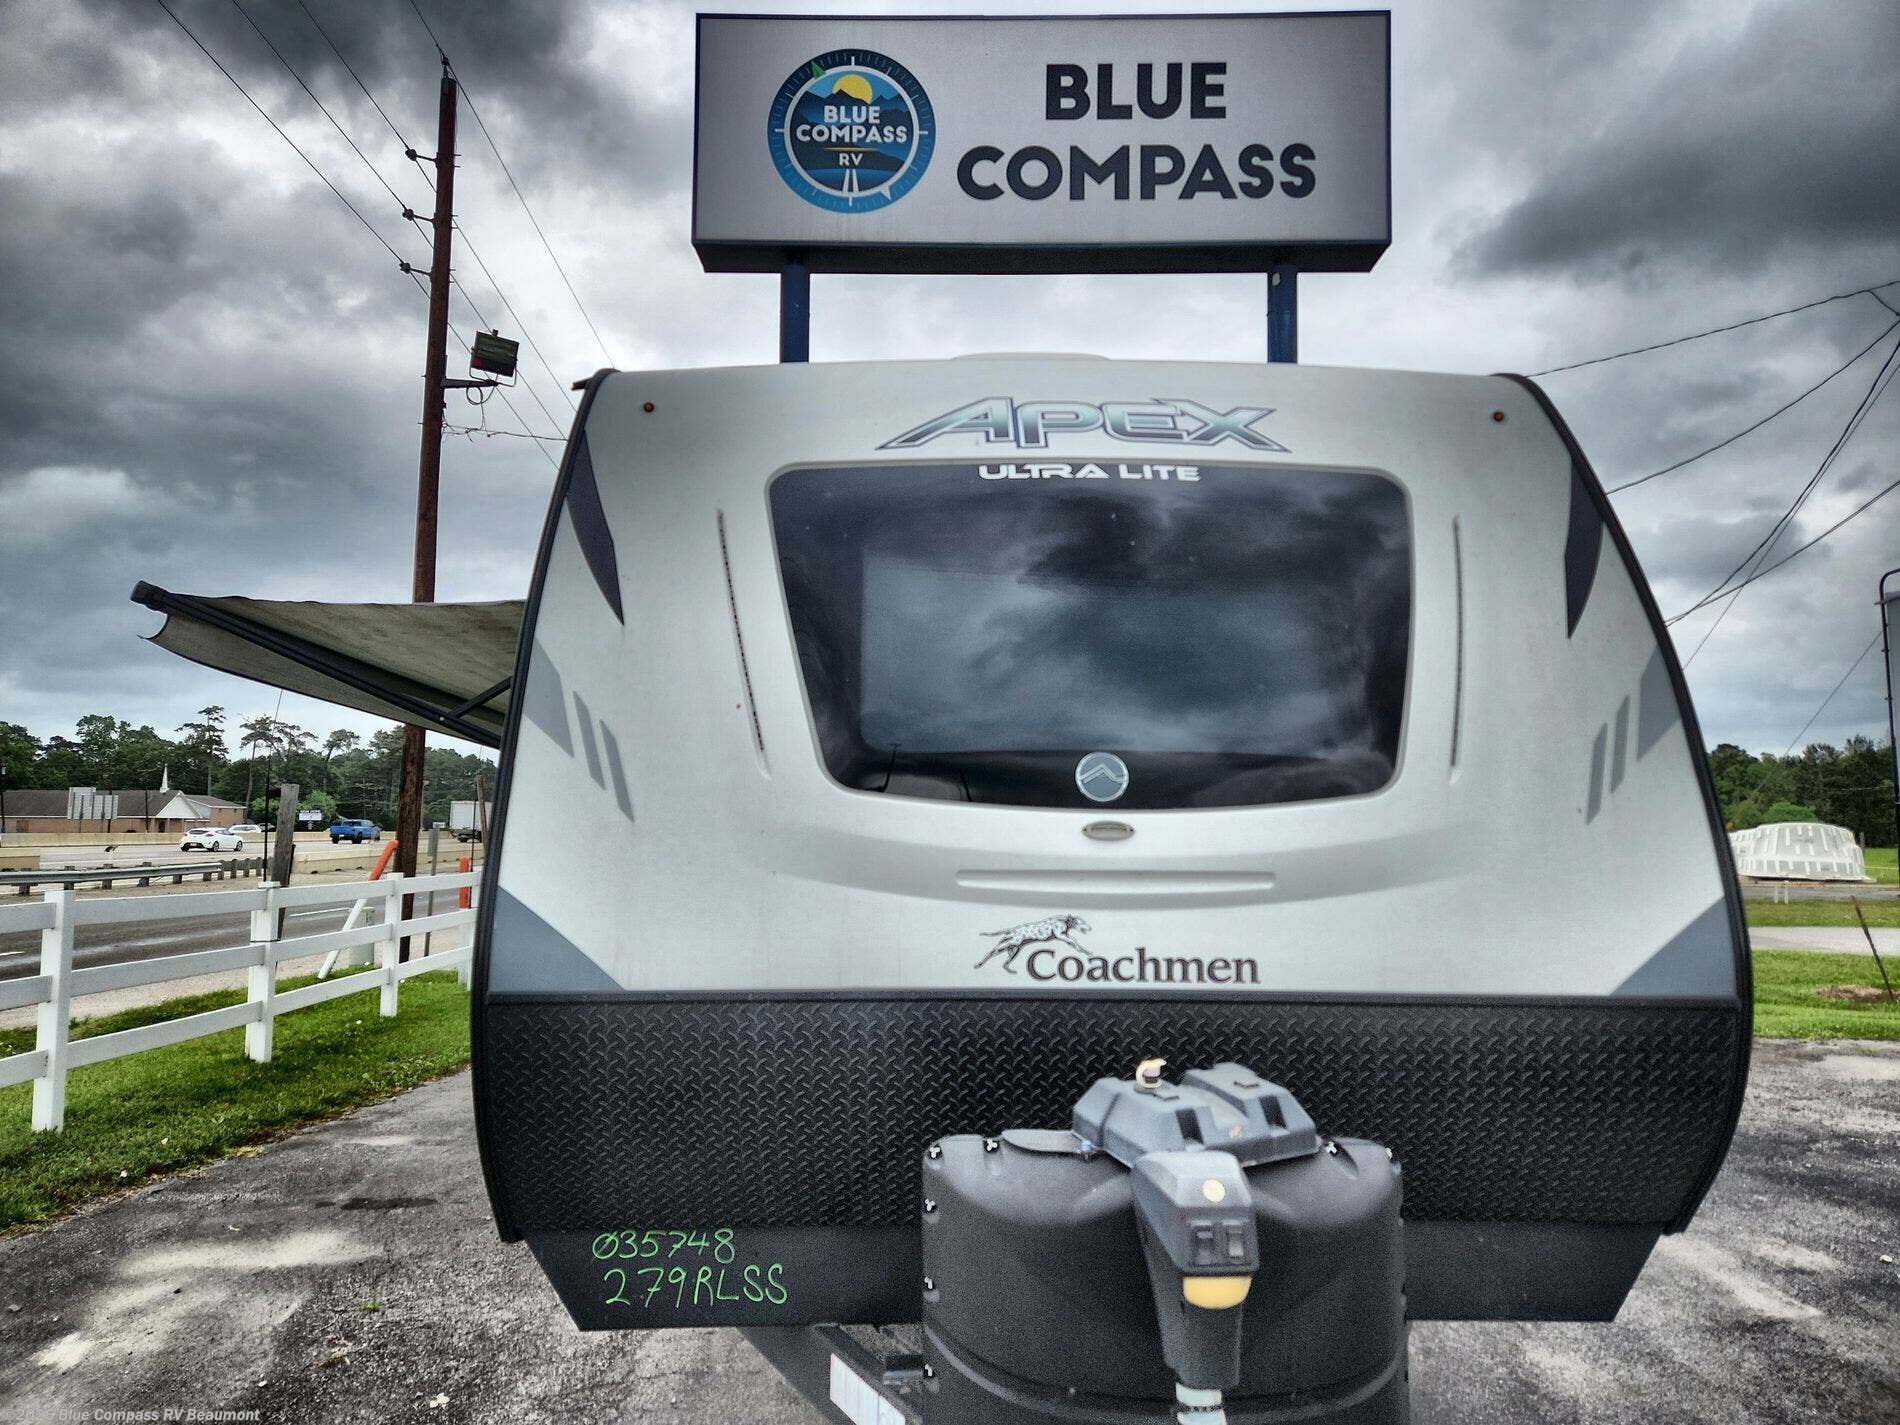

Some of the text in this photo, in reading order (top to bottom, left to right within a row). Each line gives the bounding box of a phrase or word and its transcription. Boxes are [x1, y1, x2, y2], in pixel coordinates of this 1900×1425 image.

[1045, 61, 1228, 121] BLUE
[823, 105, 881, 124] BLUE
[795, 124, 908, 143] COMPASS
[838, 152, 864, 167] RV
[956, 143, 1317, 202] COMPASS
[874, 396, 1292, 453] APEX
[977, 462, 1202, 482] ULTRA LITE
[1026, 946, 1262, 984] Coachmen
[591, 1227, 736, 1264] 035748
[603, 1262, 788, 1309] 279RLSS
